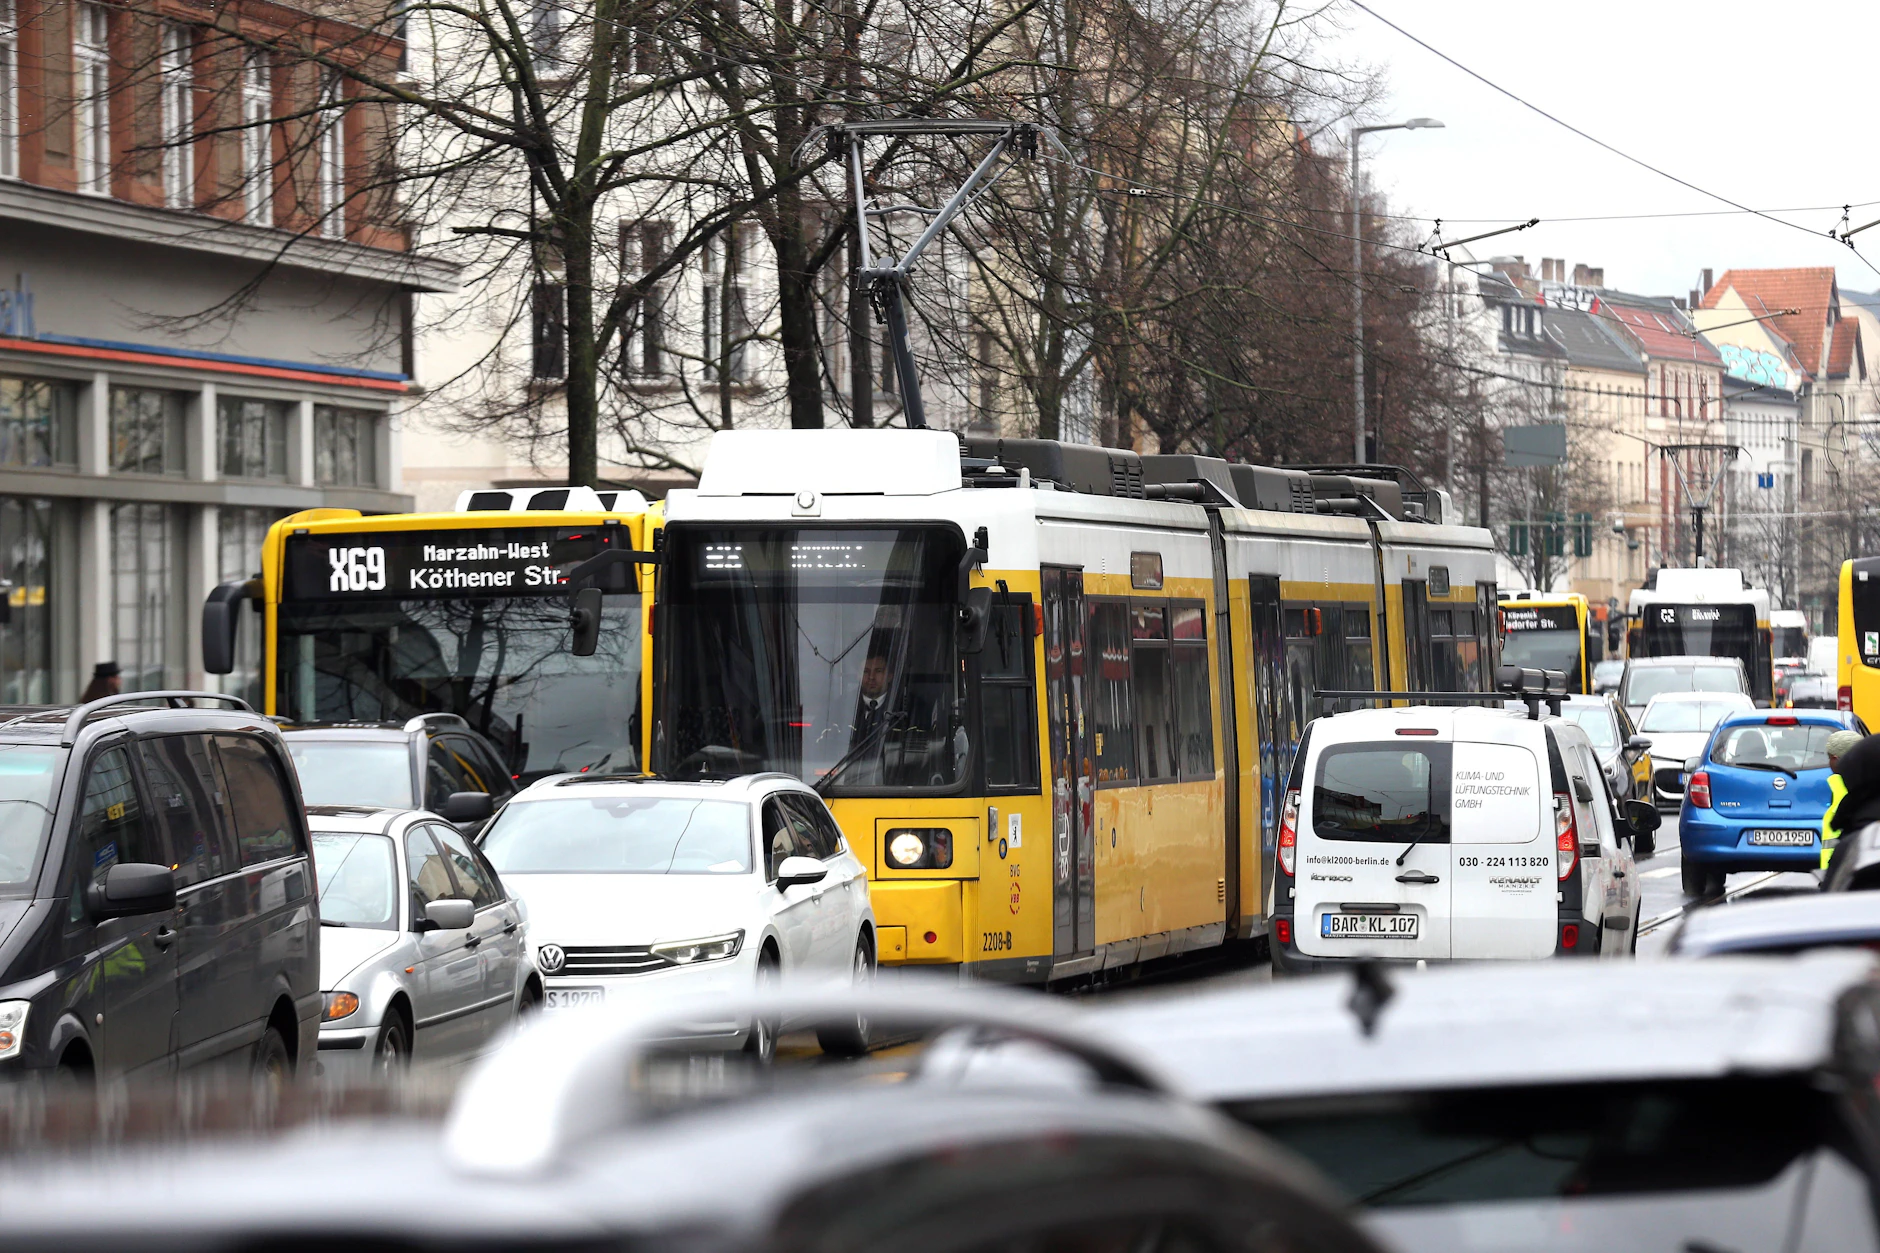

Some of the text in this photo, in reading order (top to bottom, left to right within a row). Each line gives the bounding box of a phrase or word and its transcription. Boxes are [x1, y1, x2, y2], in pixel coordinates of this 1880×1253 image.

[423, 541, 551, 562] Marzahn-West
[328, 546, 387, 592] X69
[409, 565, 567, 589] Köthener Str.
[1485, 771, 1505, 781] UND
[1455, 783, 1531, 796] LÜFTUNGSTECHNIK
[1455, 799, 1483, 808] GMBH
[1754, 831, 1761, 842] B
[1785, 831, 1811, 842] 1950
[1306, 855, 1390, 865] info@kl2000-berlin.de
[1459, 857, 1478, 867] 030
[1486, 857, 1505, 867] 224
[1508, 857, 1527, 867] 113
[1529, 857, 1549, 867] 820
[1489, 876, 1542, 884] RENAULT
[1332, 917, 1358, 932] BAR
[1368, 917, 1386, 932] KL
[1389, 917, 1416, 932] 107
